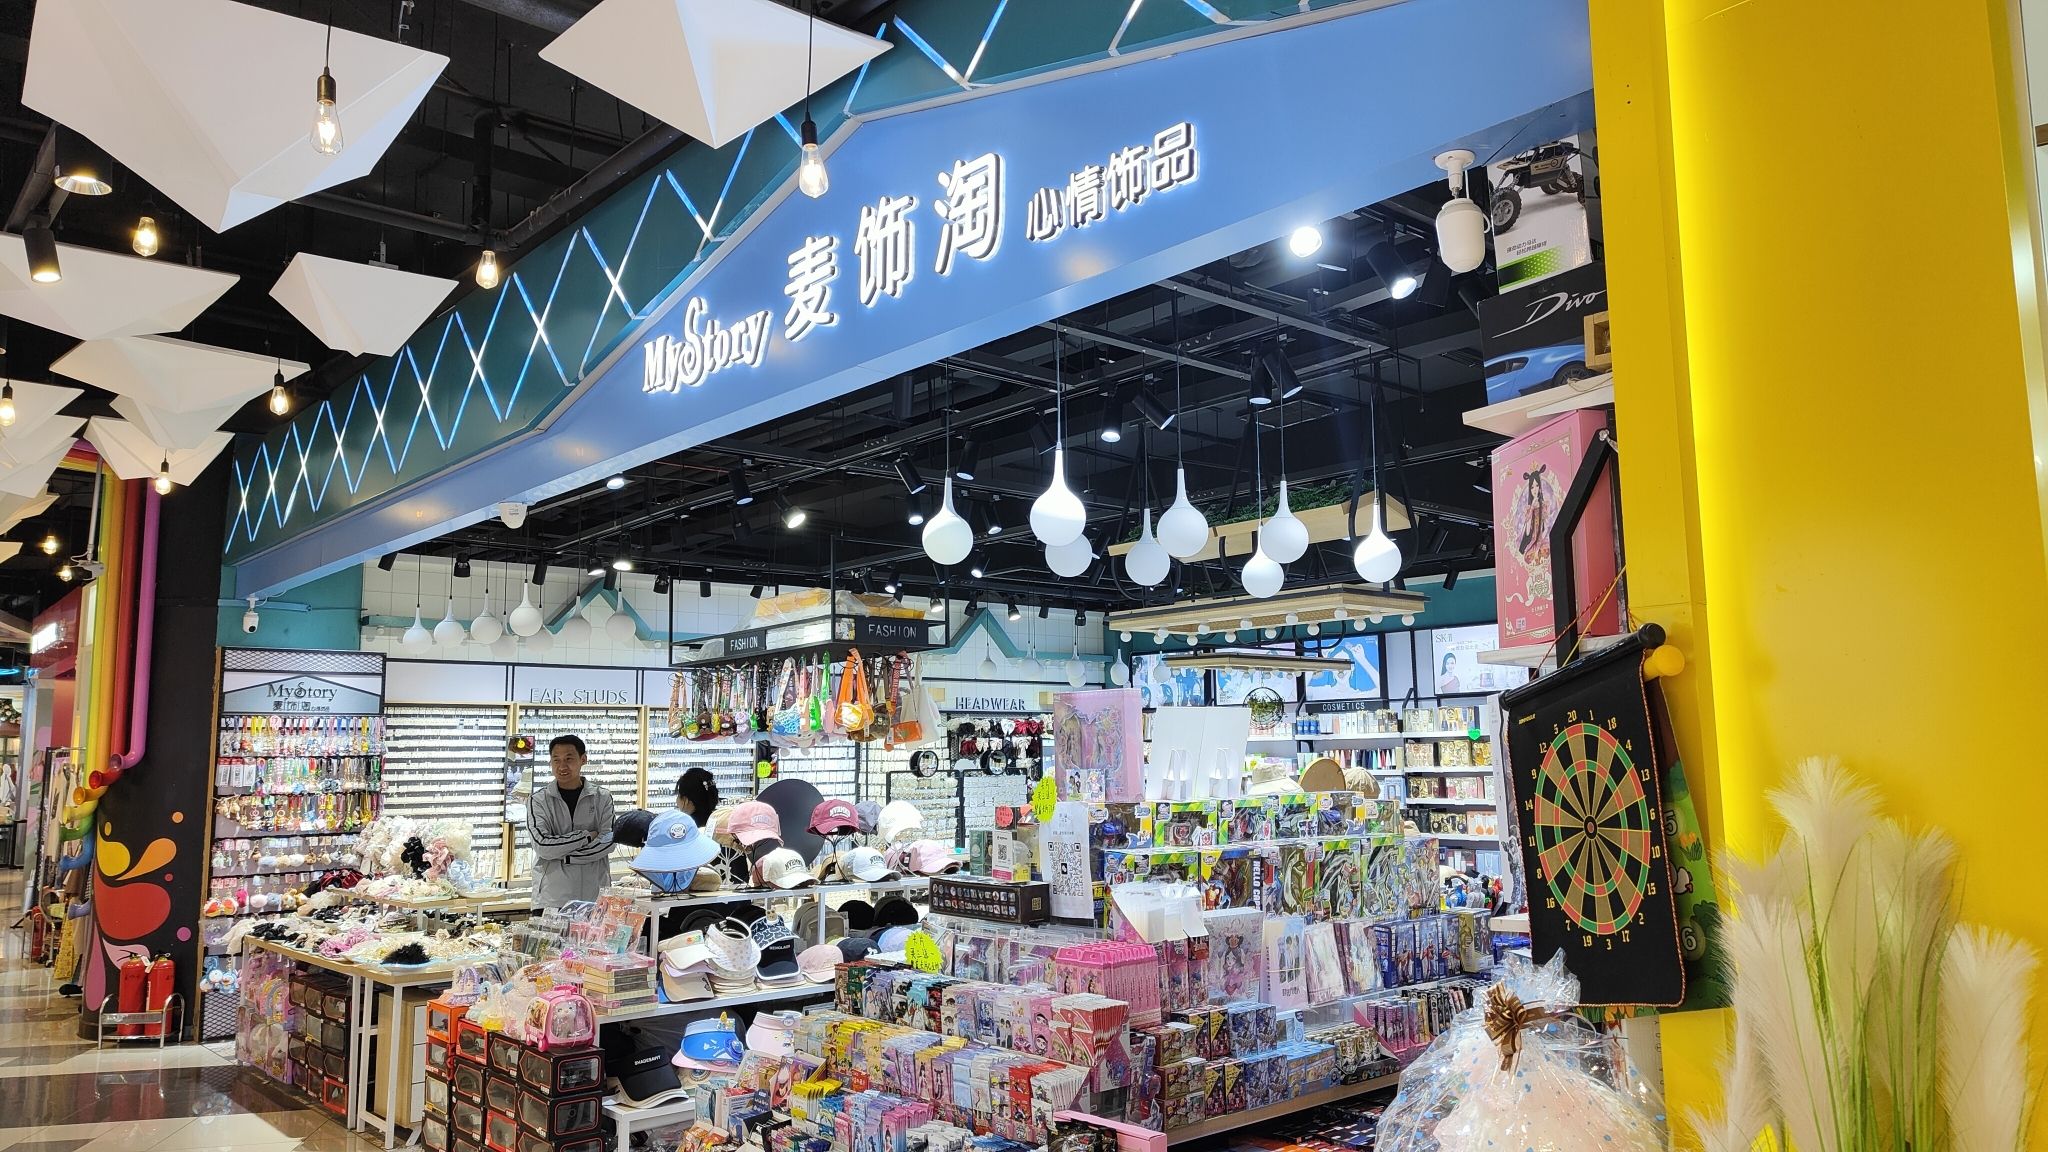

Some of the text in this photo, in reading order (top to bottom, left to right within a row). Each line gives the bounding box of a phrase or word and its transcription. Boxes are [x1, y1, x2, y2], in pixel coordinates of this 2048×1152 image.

[1026, 121, 1198, 242] 心情饰品
[784, 152, 1006, 341] 麦饰淘
[1491, 289, 1606, 339] Divo
[643, 297, 770, 395] MyStory
[868, 623, 917, 639] FASHION
[730, 635, 758, 651] FASHION
[266, 681, 338, 701] MyStory
[530, 688, 628, 705] EAR STUDS
[955, 696, 1026, 712] HEADWEAR
[1322, 702, 1366, 712] COSMETICS
[1567, 710, 1577, 723] 20
[1589, 709, 1594, 721] 1
[1553, 723, 1559, 735] 5
[1607, 717, 1617, 731] 18
[1539, 742, 1548, 754] 12
[1625, 739, 1633, 751] 4
[1531, 769, 1537, 780] 9
[1640, 768, 1650, 782] 13
[1524, 799, 1534, 811] 14
[1649, 808, 1656, 821] 6
[1528, 835, 1536, 847] 11
[1651, 845, 1661, 859] 10
[1252, 861, 1261, 887] HELLO
[1536, 868, 1542, 880] 8
[1646, 882, 1657, 896] 15
[1546, 897, 1556, 909] 16
[1638, 912, 1645, 925] 2
[1565, 919, 1571, 932] 7
[1582, 935, 1593, 947] 19
[1621, 930, 1630, 943] 17
[1681, 926, 1698, 952] 6
[1606, 938, 1612, 951] 3
